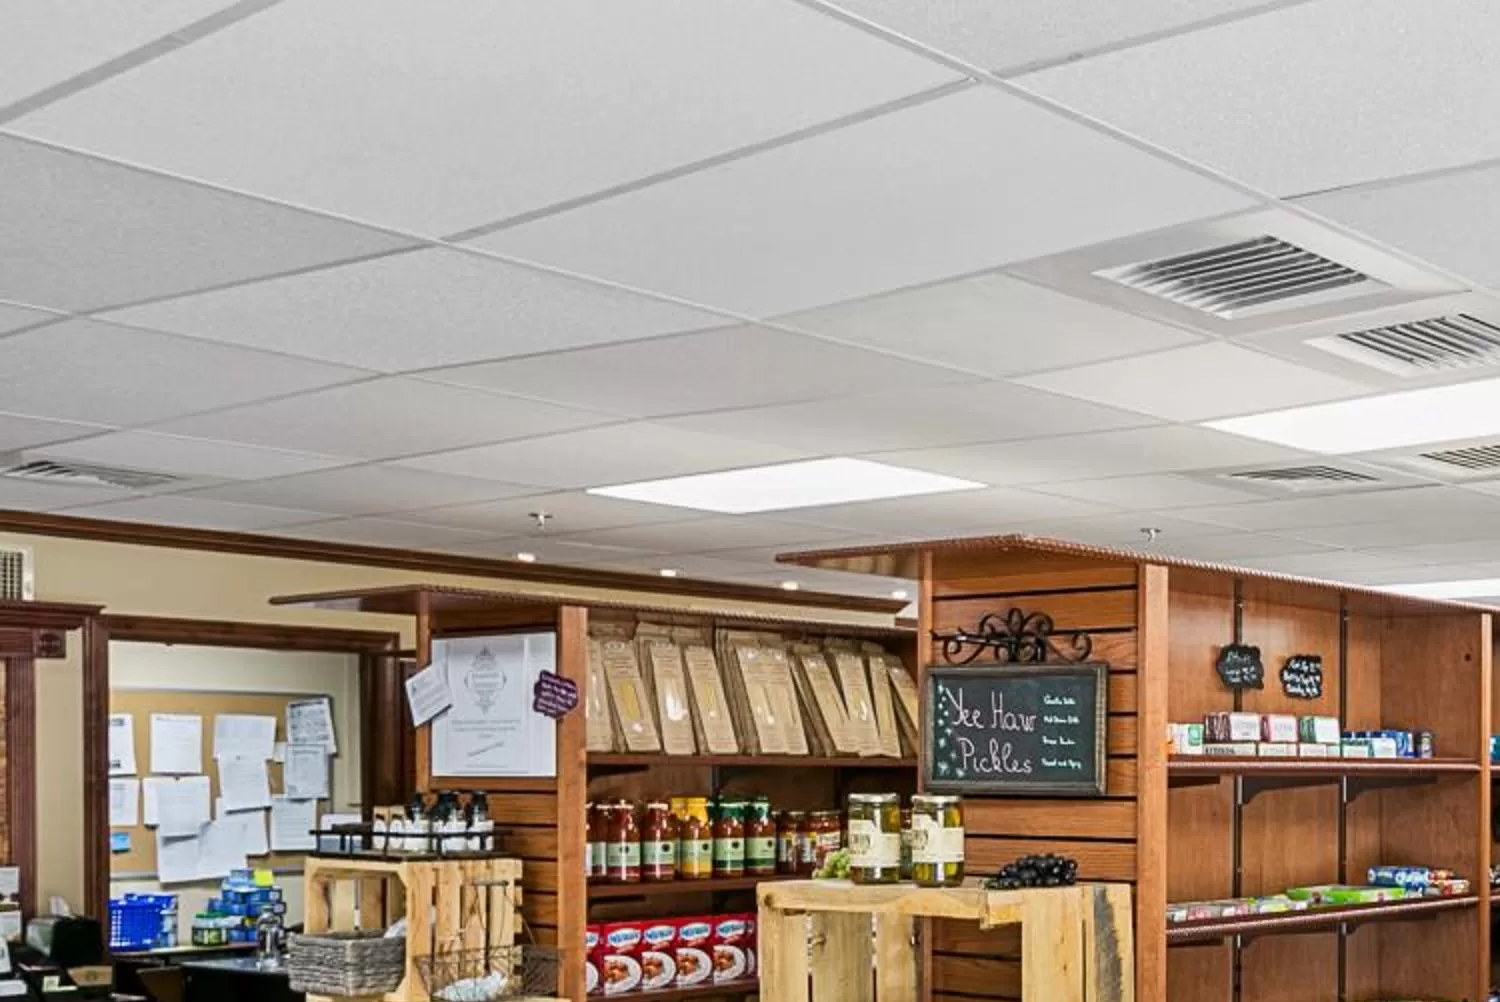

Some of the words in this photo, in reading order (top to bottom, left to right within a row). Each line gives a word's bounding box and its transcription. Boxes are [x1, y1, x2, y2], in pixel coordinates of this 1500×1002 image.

[945, 687, 984, 730] Yee
[990, 690, 1037, 732] Haw
[956, 736, 1033, 774] Pickles
